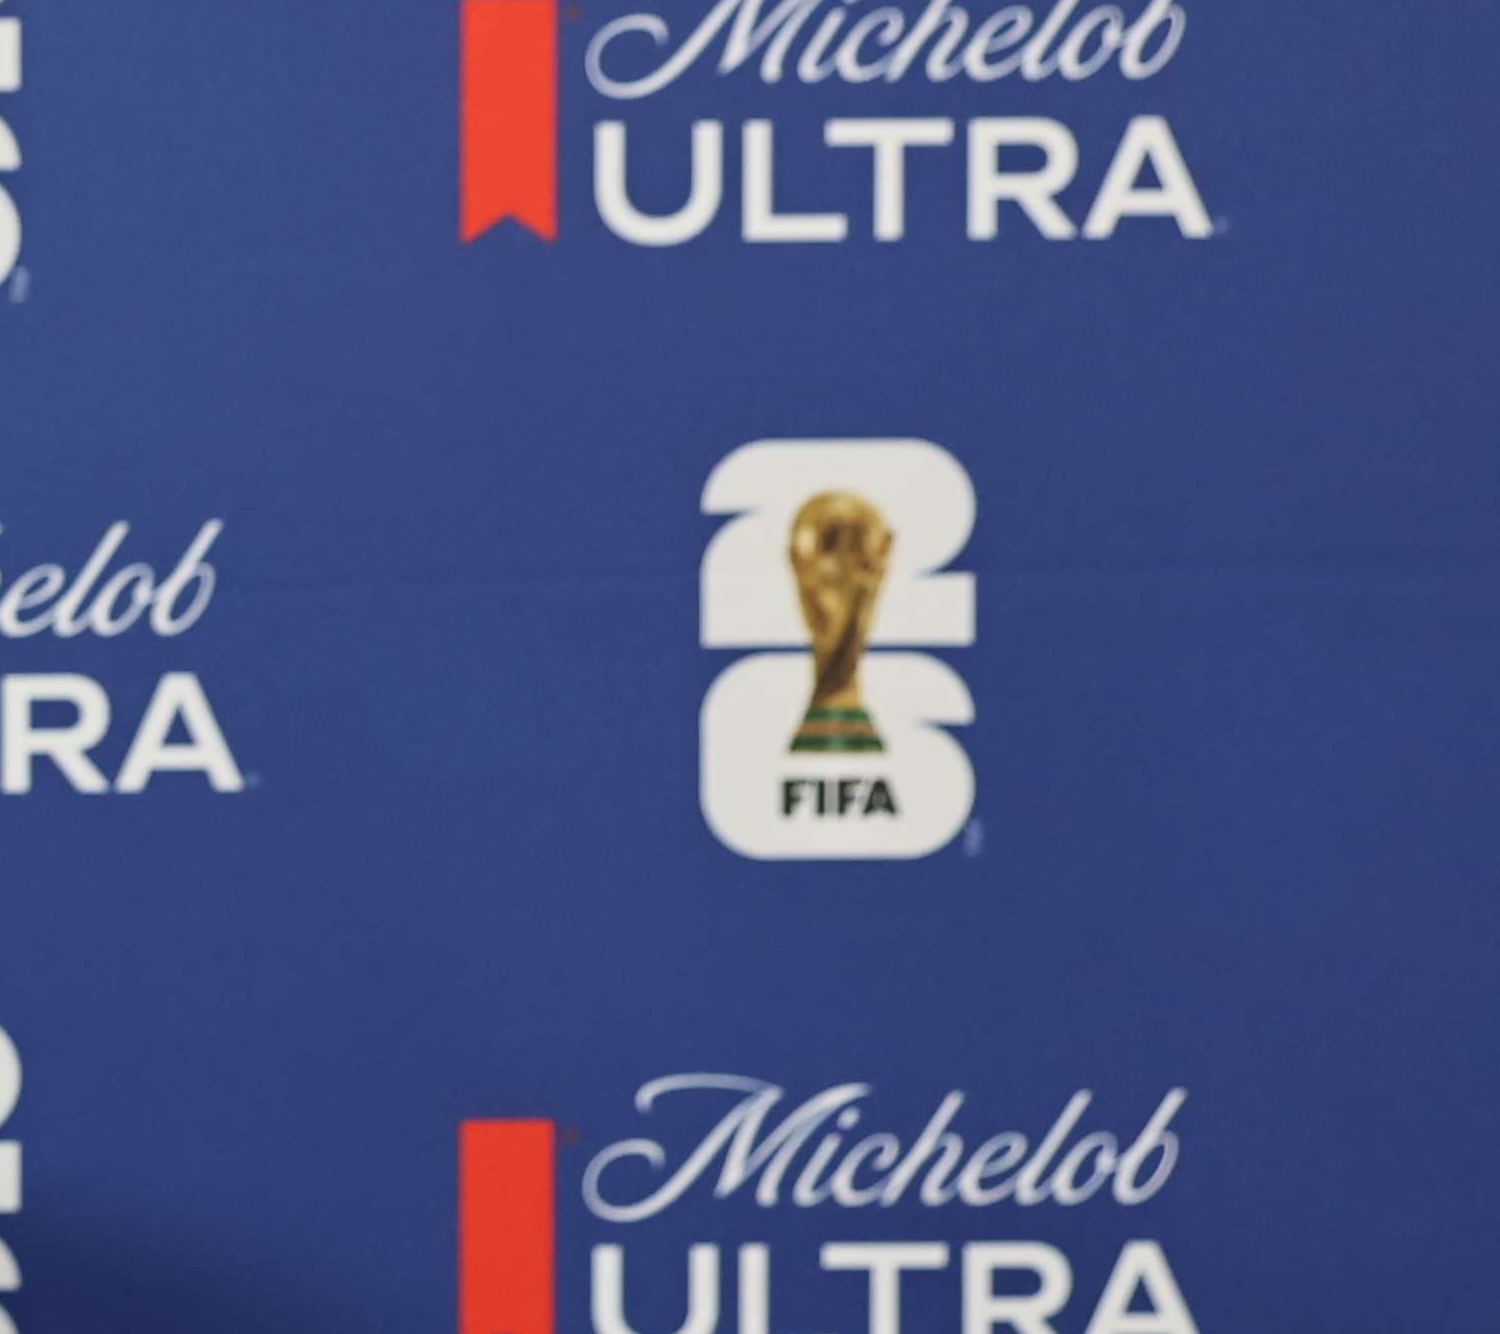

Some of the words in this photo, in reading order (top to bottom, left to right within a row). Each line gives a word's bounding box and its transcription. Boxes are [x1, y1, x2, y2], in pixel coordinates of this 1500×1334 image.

[595, 117, 1211, 245] ULTRA
[783, 779, 896, 816] FIFA
[584, 1076, 1184, 1221] Michelob
